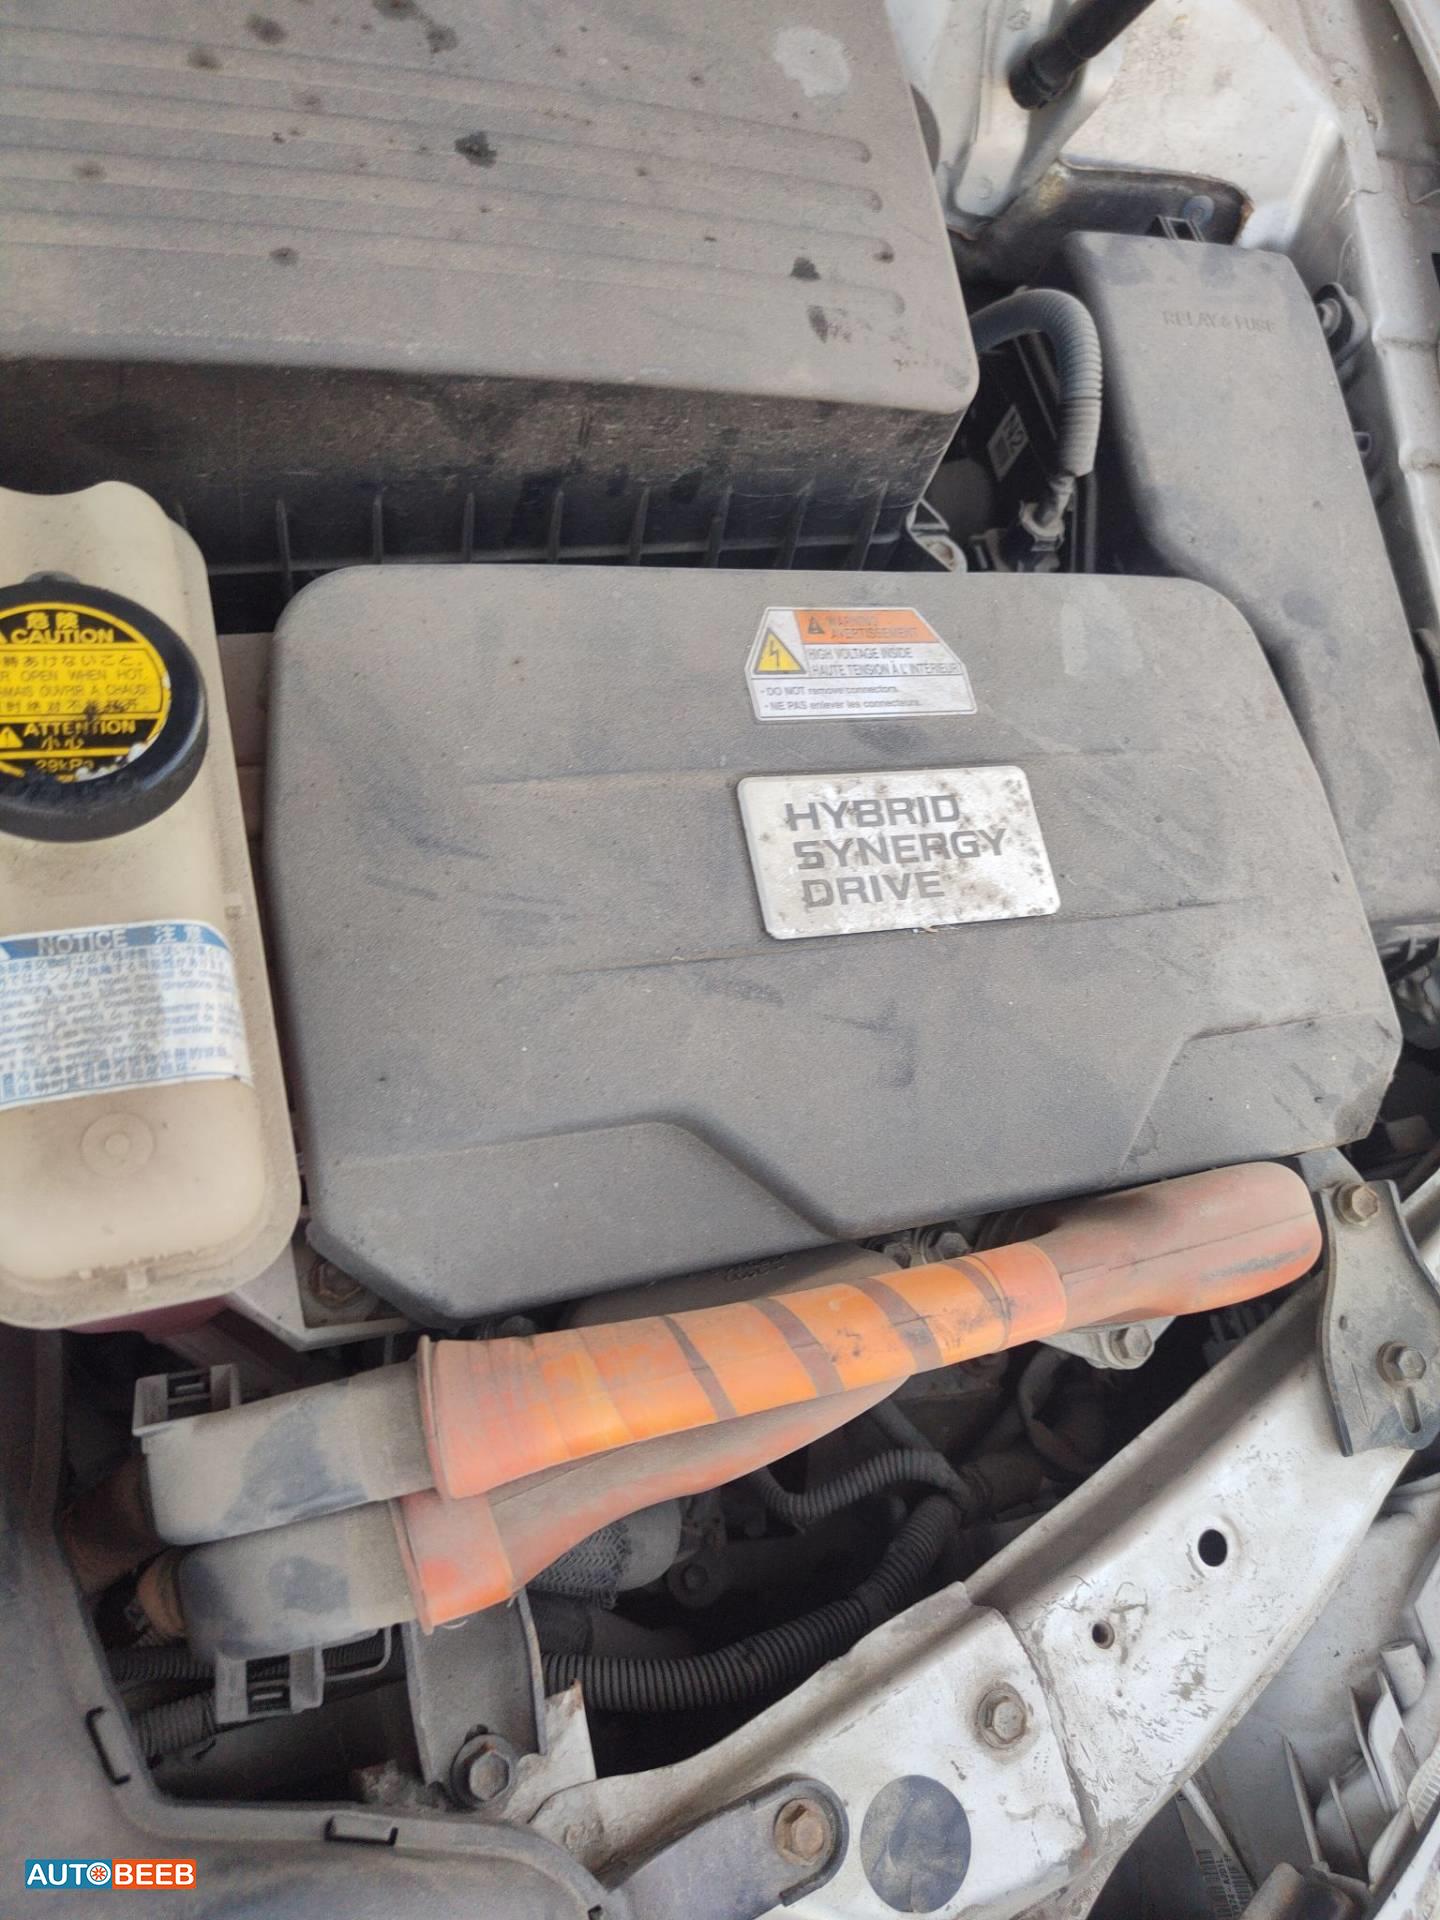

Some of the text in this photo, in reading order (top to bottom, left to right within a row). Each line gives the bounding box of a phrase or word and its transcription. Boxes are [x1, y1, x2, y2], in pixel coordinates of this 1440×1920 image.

[10, 628, 115, 644] CAUTION
[836, 647, 879, 660] VOLTAGE
[881, 647, 913, 659] INSIDE
[21, 669, 58, 681] OPEN
[70, 669, 108, 681] WHEN
[847, 662, 889, 675] TENSION
[785, 686, 805, 696] NOT
[23, 720, 137, 737] ATTENTION
[785, 795, 961, 832] HYBRID
[793, 828, 1007, 870] SYNERGY
[801, 871, 946, 909] DRIVE
[38, 928, 128, 956] NOTICE
